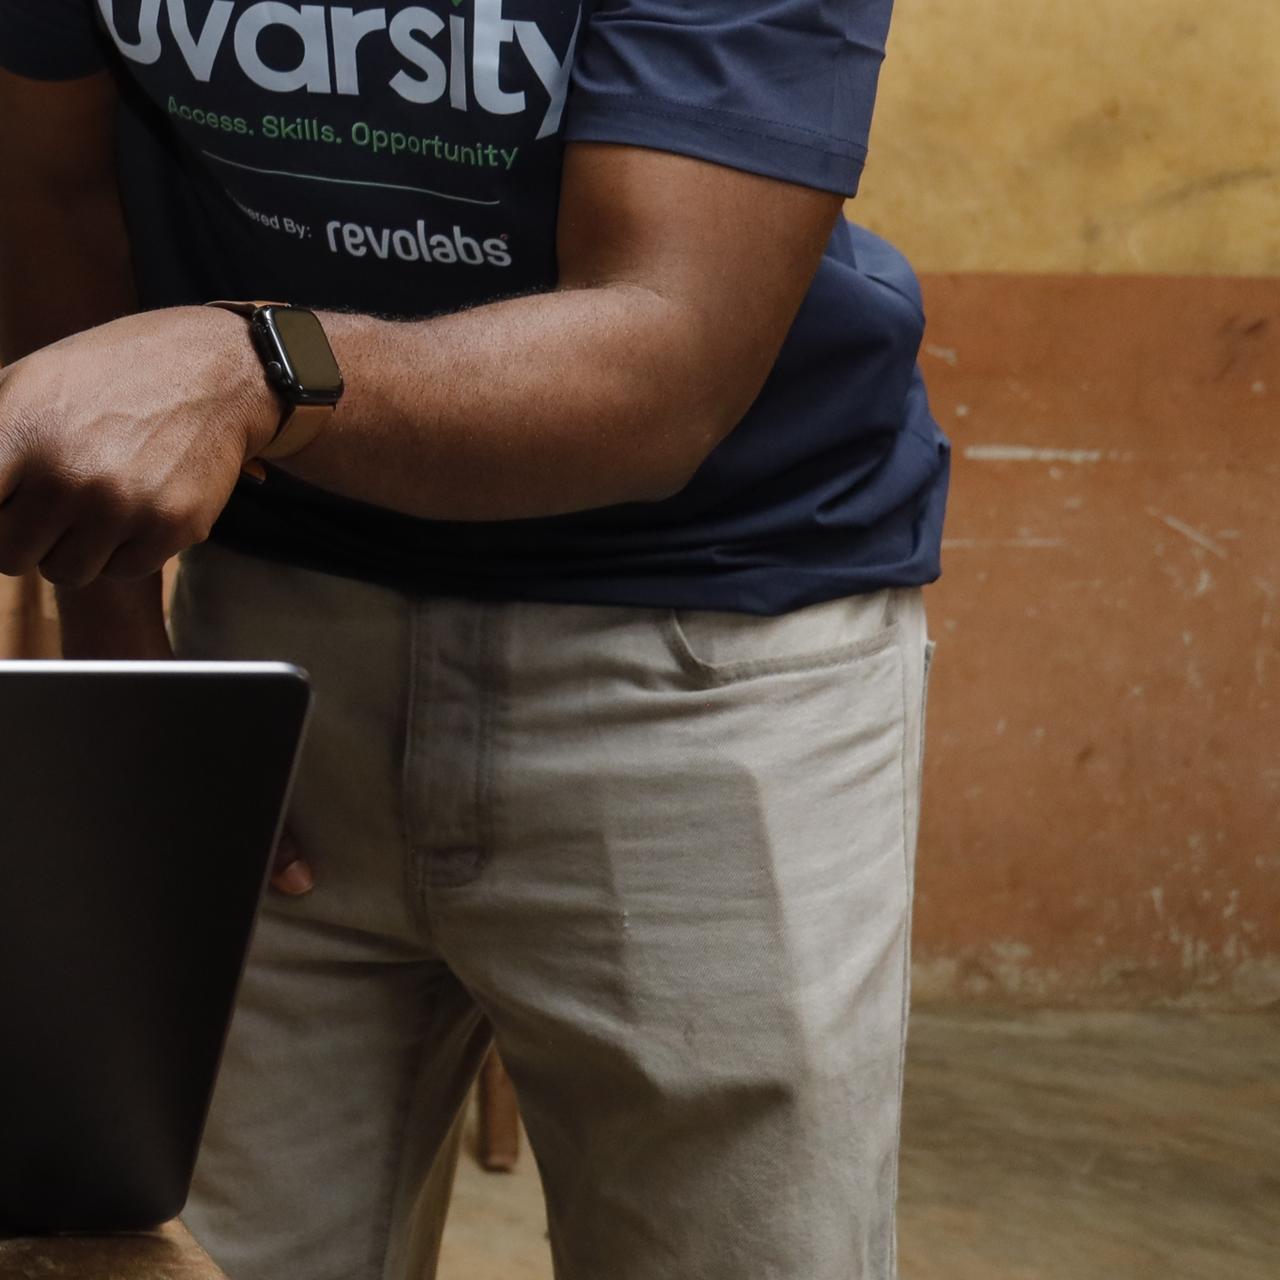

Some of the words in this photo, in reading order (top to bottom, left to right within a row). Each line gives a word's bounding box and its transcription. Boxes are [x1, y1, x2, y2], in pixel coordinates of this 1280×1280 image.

[167, 94, 256, 137] Access.
[260, 114, 343, 146] Skills.
[350, 121, 520, 170] Opportunity
[283, 216, 313, 240] By:
[326, 219, 512, 268] revolabs
